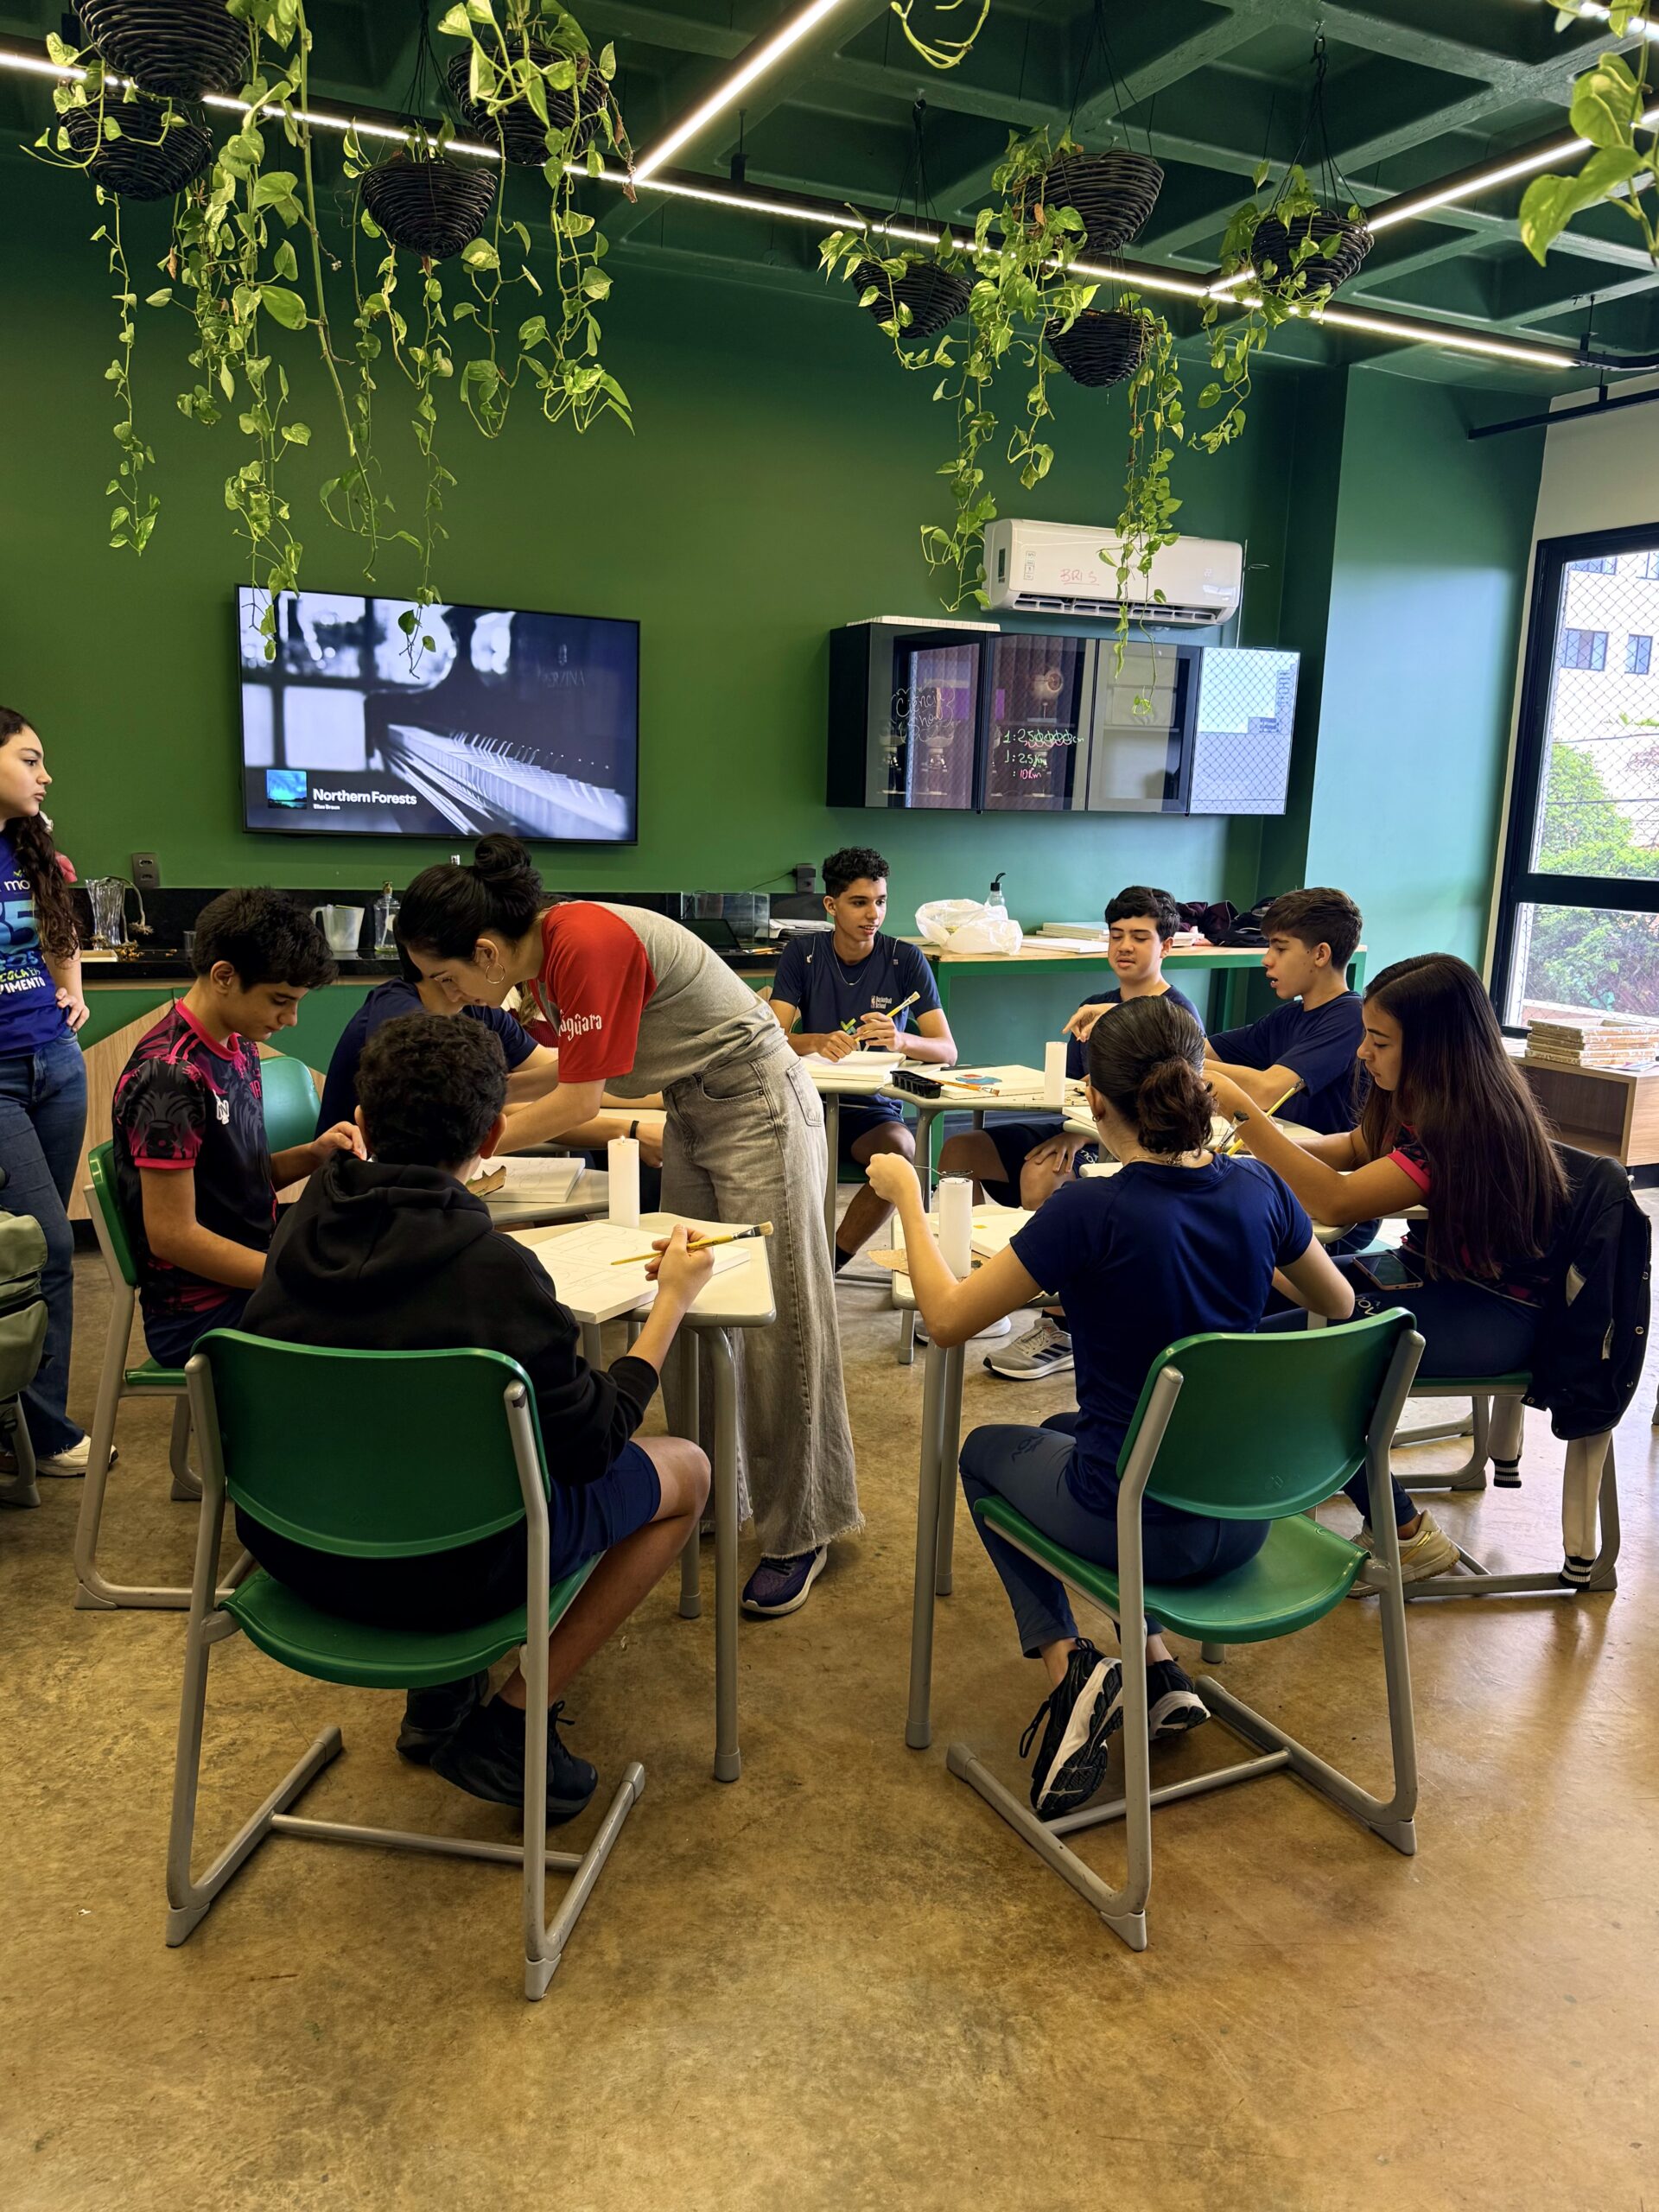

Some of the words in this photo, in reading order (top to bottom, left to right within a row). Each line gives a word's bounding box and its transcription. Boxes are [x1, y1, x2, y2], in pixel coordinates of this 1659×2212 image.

[313, 788, 371, 803] Northern
[372, 791, 417, 804] Forests
[0, 969, 30, 983] COLA
[0, 976, 46, 995] IMENTO
